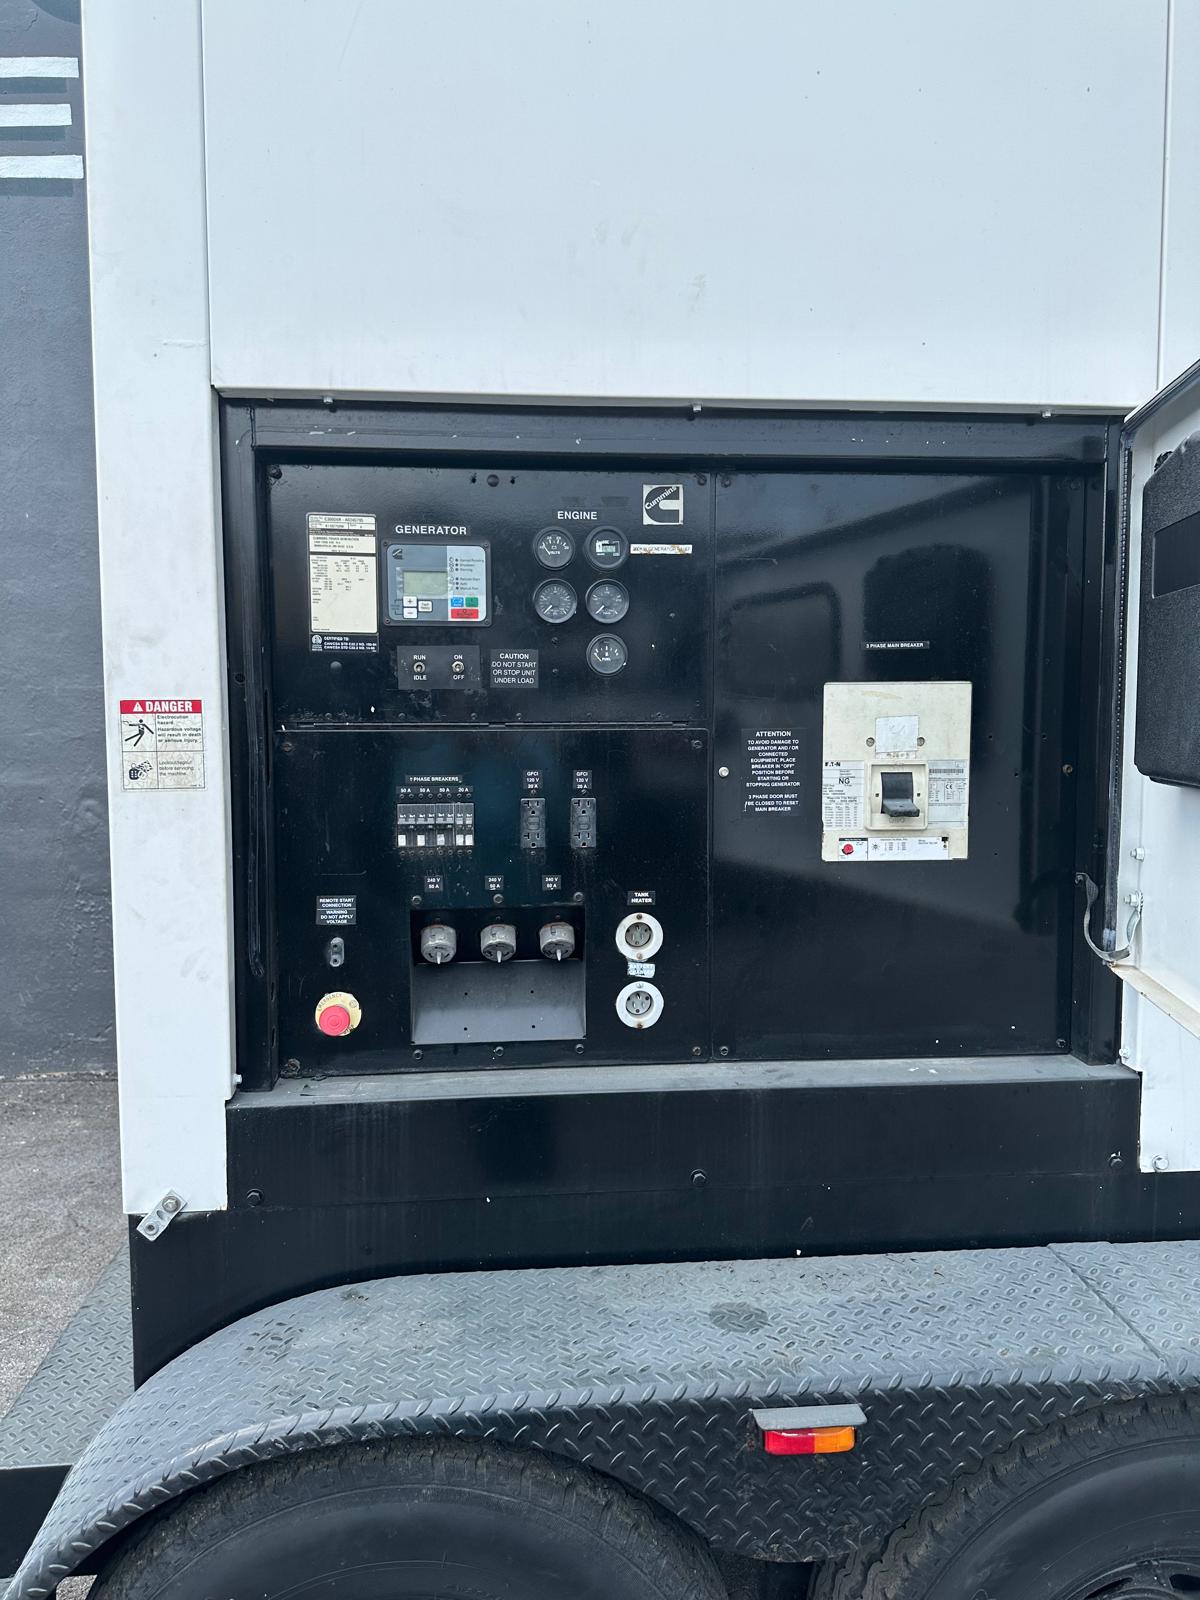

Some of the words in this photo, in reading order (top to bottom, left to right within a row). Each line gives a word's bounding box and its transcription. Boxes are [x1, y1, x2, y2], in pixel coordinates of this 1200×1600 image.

[645, 486, 677, 509] Cummins
[557, 511, 597, 520] ENGINE
[395, 525, 467, 535] GENERATOR
[146, 701, 193, 712] DANGER
[838, 777, 850, 785] NG
